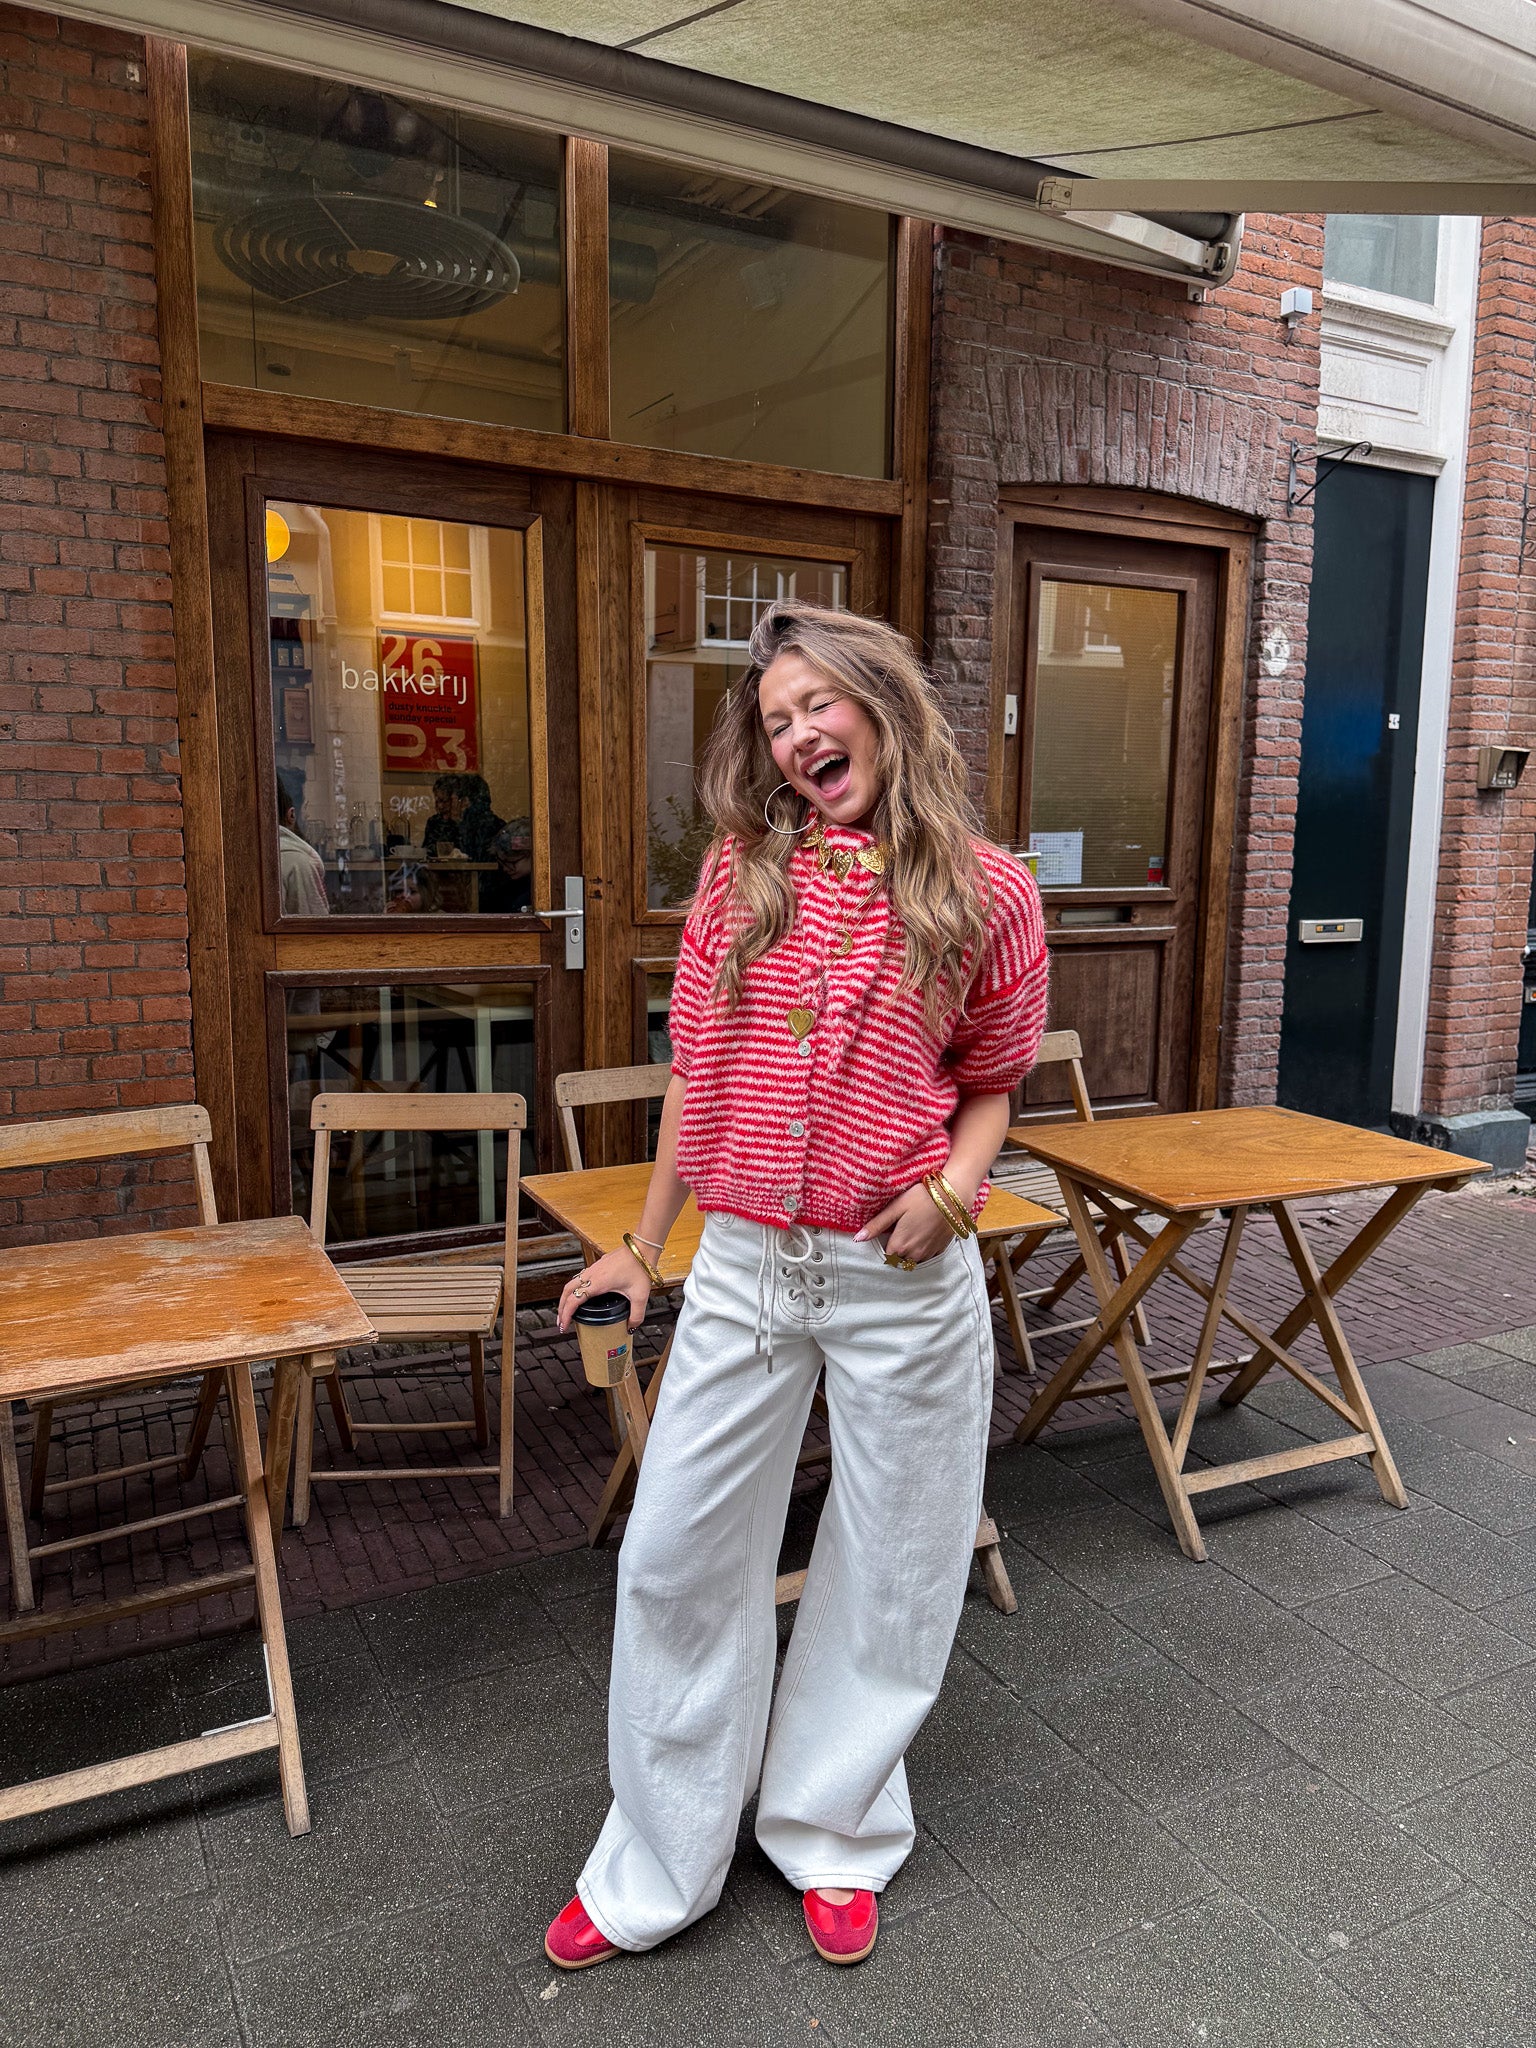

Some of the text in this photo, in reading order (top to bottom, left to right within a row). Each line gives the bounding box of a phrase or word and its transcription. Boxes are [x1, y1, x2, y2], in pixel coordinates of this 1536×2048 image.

[382, 634, 444, 689] 26
[341, 661, 467, 704] bakkerij
[388, 702, 452, 713] dusty knuckle
[388, 713, 456, 724] sunday special
